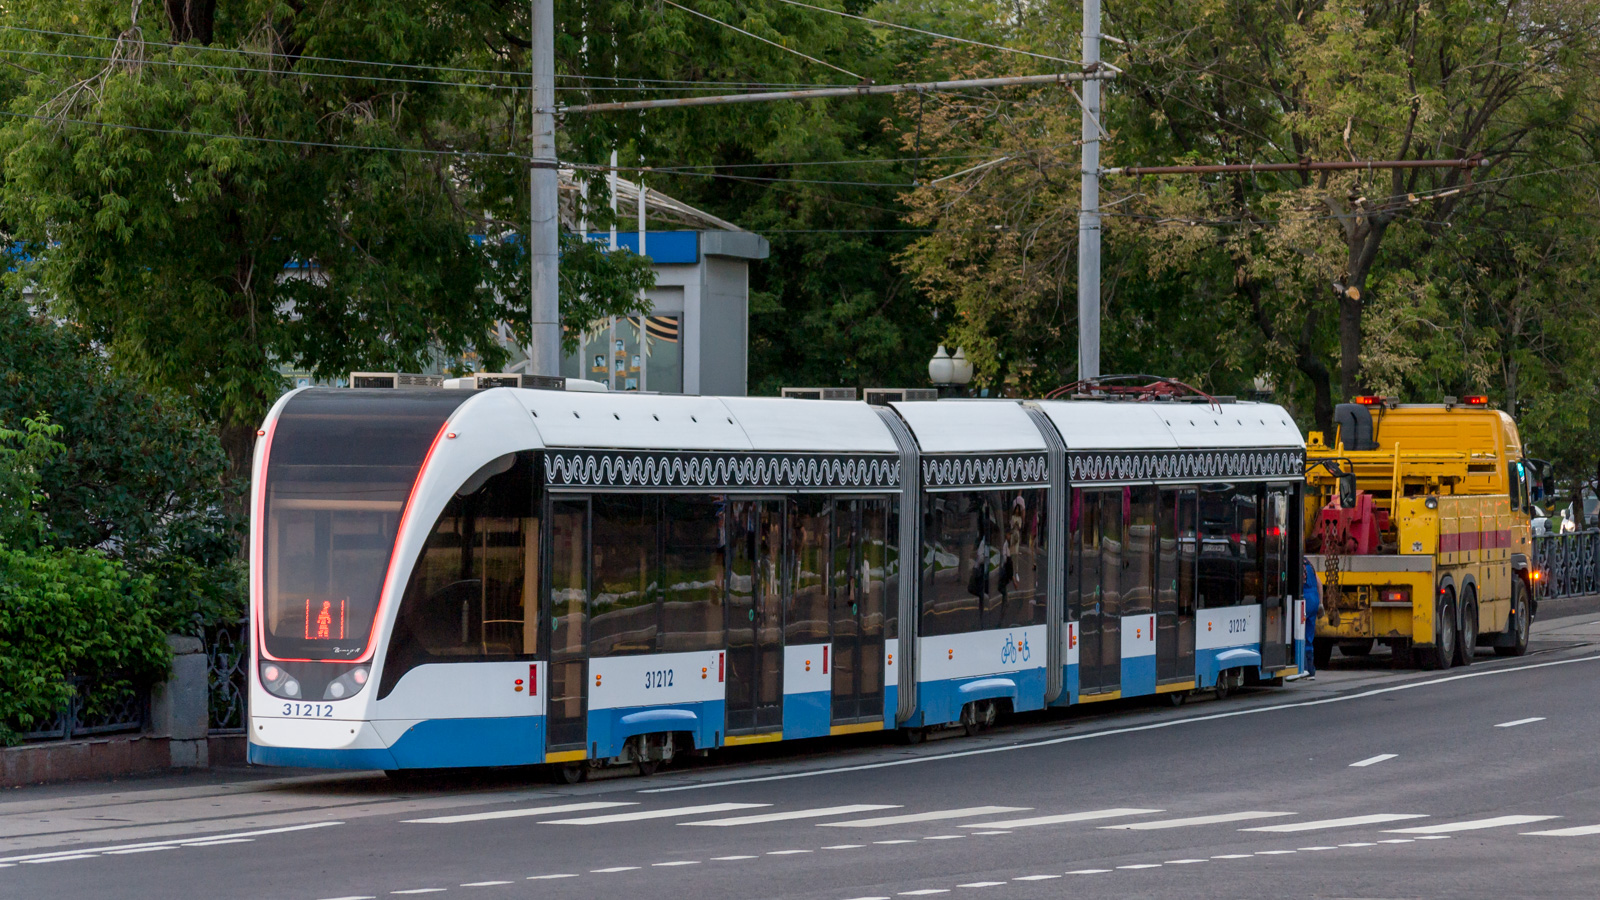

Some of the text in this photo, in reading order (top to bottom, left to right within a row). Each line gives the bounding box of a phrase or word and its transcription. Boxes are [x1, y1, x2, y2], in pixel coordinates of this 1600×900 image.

[1229, 618, 1246, 633] 31212
[645, 669, 673, 689] 31212
[282, 703, 333, 717] 31212
